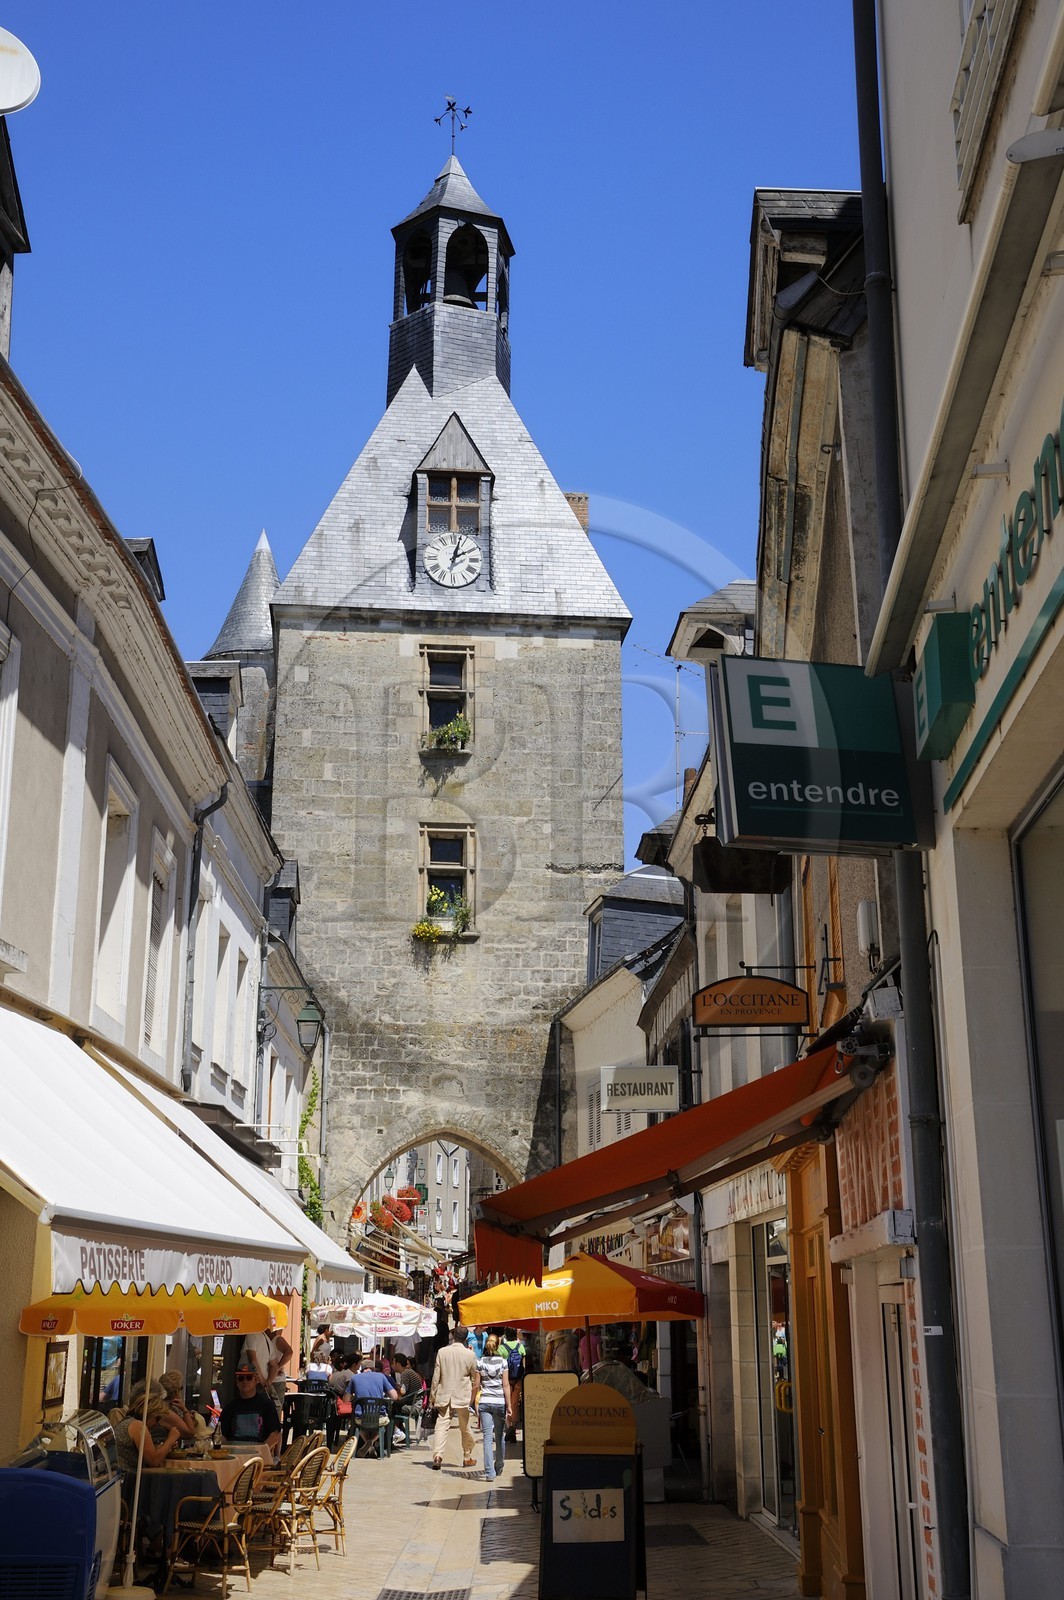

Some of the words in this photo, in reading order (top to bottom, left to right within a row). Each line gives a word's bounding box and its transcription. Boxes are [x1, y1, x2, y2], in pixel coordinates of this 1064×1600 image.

[746, 674, 797, 731] E
[747, 779, 900, 808] entendre
[702, 992, 801, 1007] L'OCCITANE
[606, 1082, 675, 1097] RESTAURANT
[80, 1246, 145, 1281] PATISSERIE
[269, 1263, 293, 1287] GLACES
[534, 1300, 559, 1312] MIKO
[113, 1320, 141, 1330] JOKER
[215, 1319, 238, 1329] JOKER
[557, 1405, 629, 1418] L'OCCITANE
